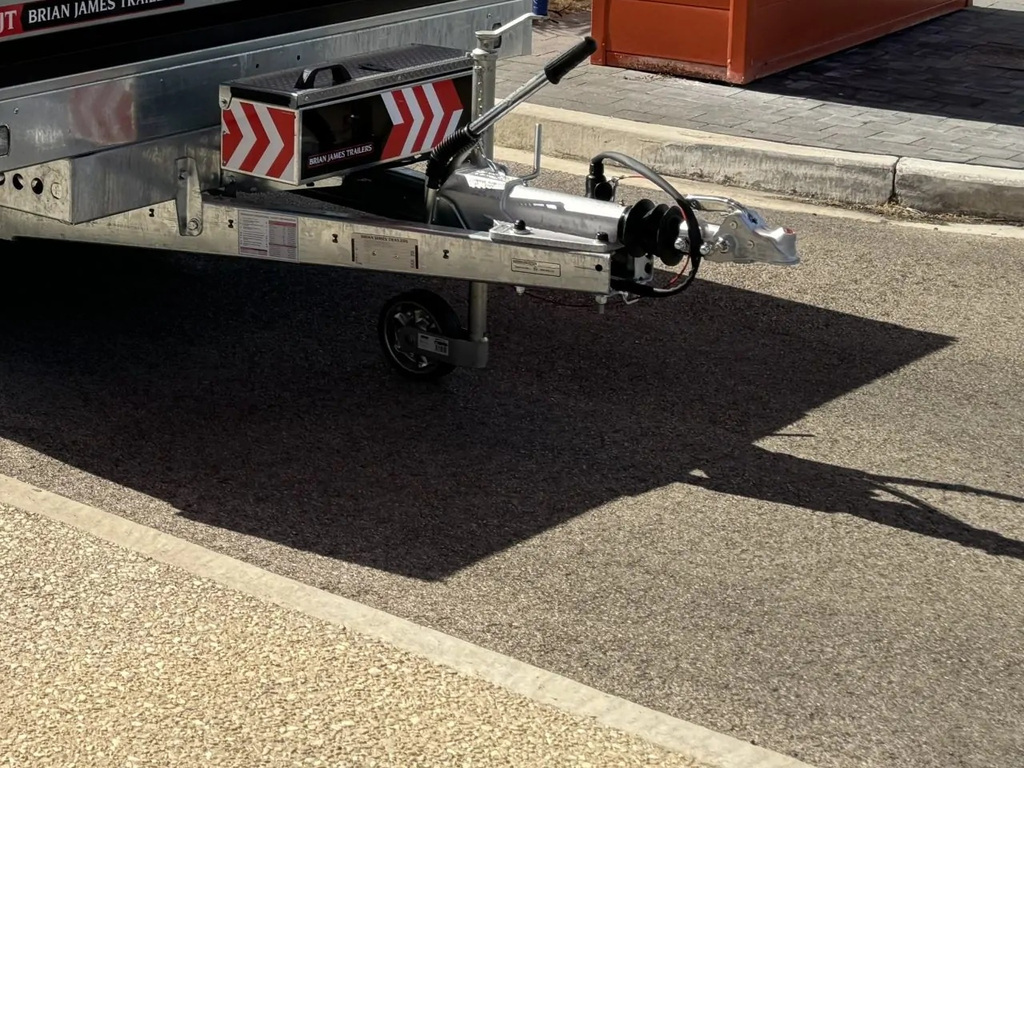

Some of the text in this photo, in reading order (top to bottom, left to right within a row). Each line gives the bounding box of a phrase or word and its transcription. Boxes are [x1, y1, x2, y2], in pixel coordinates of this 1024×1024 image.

[28, 4, 70, 24] BRIAN
[309, 144, 373, 166] BRIAN JAMES TRAILERS
